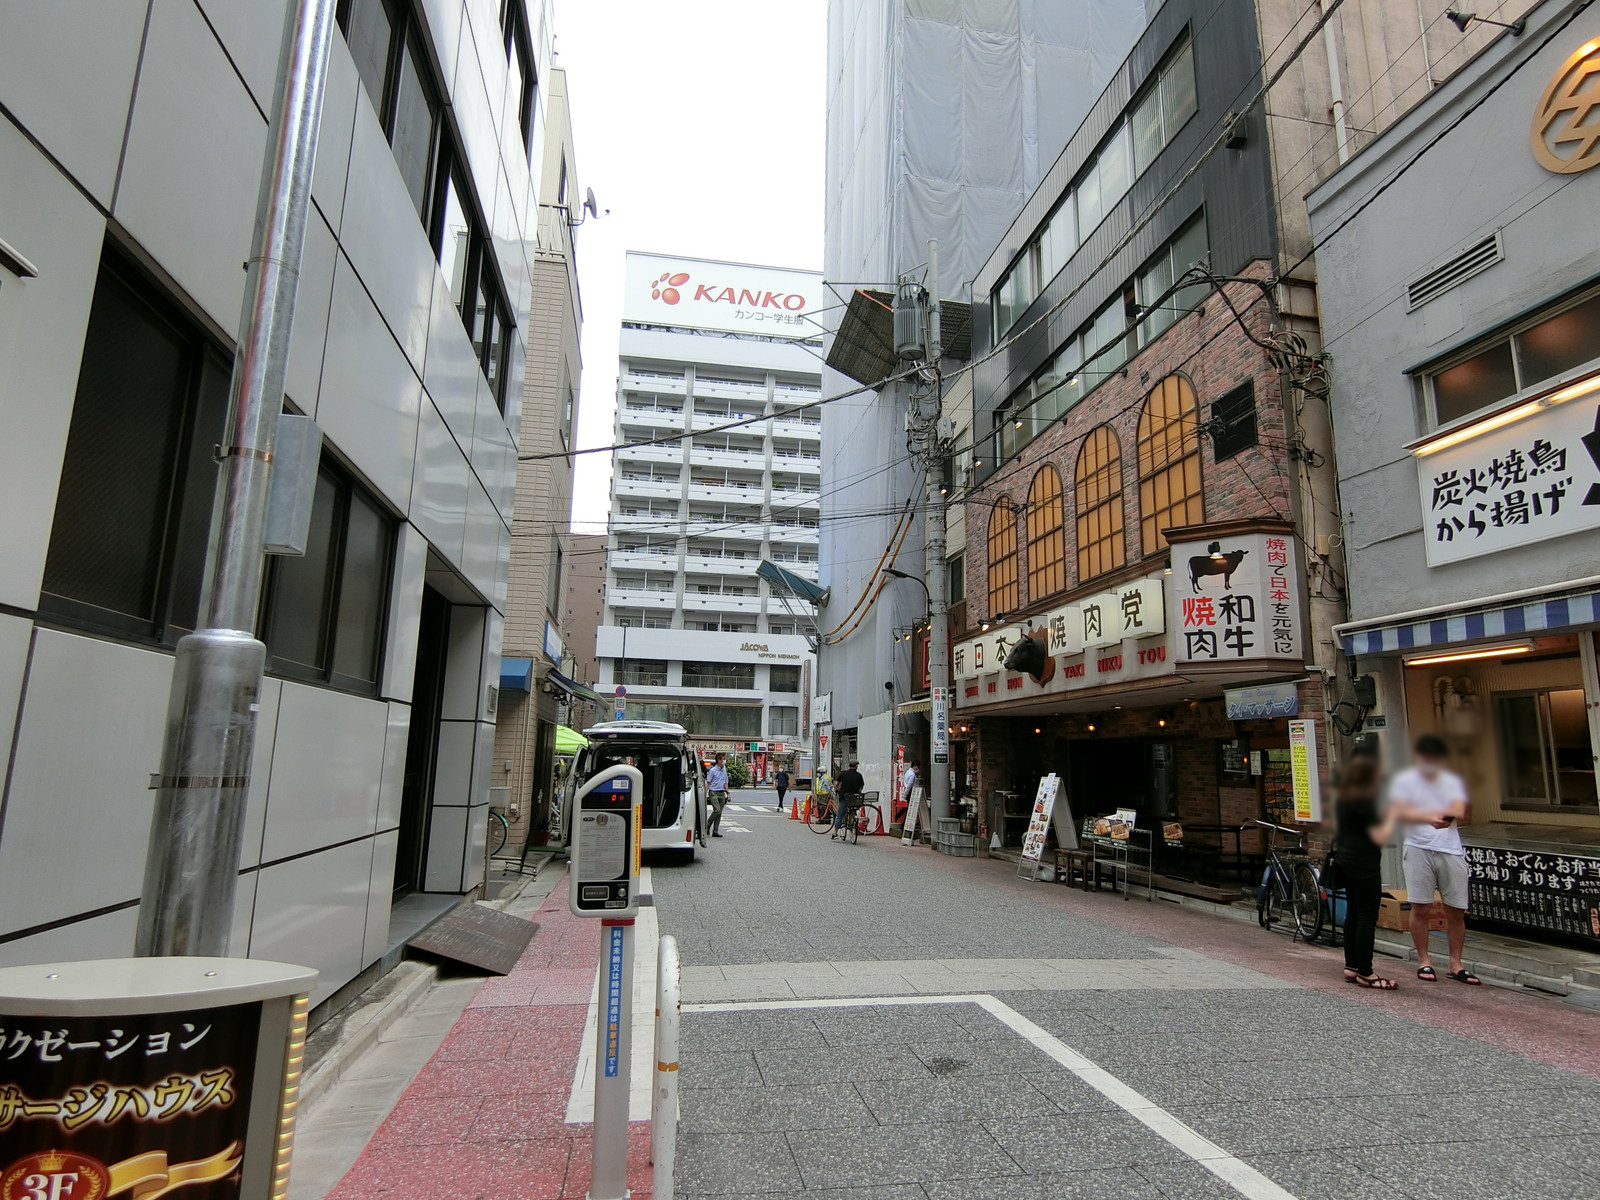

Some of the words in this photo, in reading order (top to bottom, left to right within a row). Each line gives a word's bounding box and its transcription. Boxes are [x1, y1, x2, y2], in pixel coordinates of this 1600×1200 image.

[694, 285, 805, 311] KANKO
[734, 309, 804, 326] カンコー学生服
[1431, 439, 1567, 512] 炭火焼鳥
[1436, 476, 1573, 542] から揚げ
[1266, 538, 1293, 654] 焼肉で日本を元気に
[1182, 596, 1218, 660] 焼肉
[1218, 594, 1255, 657] 和牛
[1063, 663, 1085, 679] YAKI
[1097, 655, 1123, 673] NIKU
[1137, 645, 1166, 665] TOU
[936, 702, 946, 741] 川名薬局
[1228, 695, 1296, 719] タイ・マッサージ
[1518, 869, 1576, 891] 承ります
[0, 1069, 233, 1130] サージハウス
[21, 1173, 78, 1200] 3F
